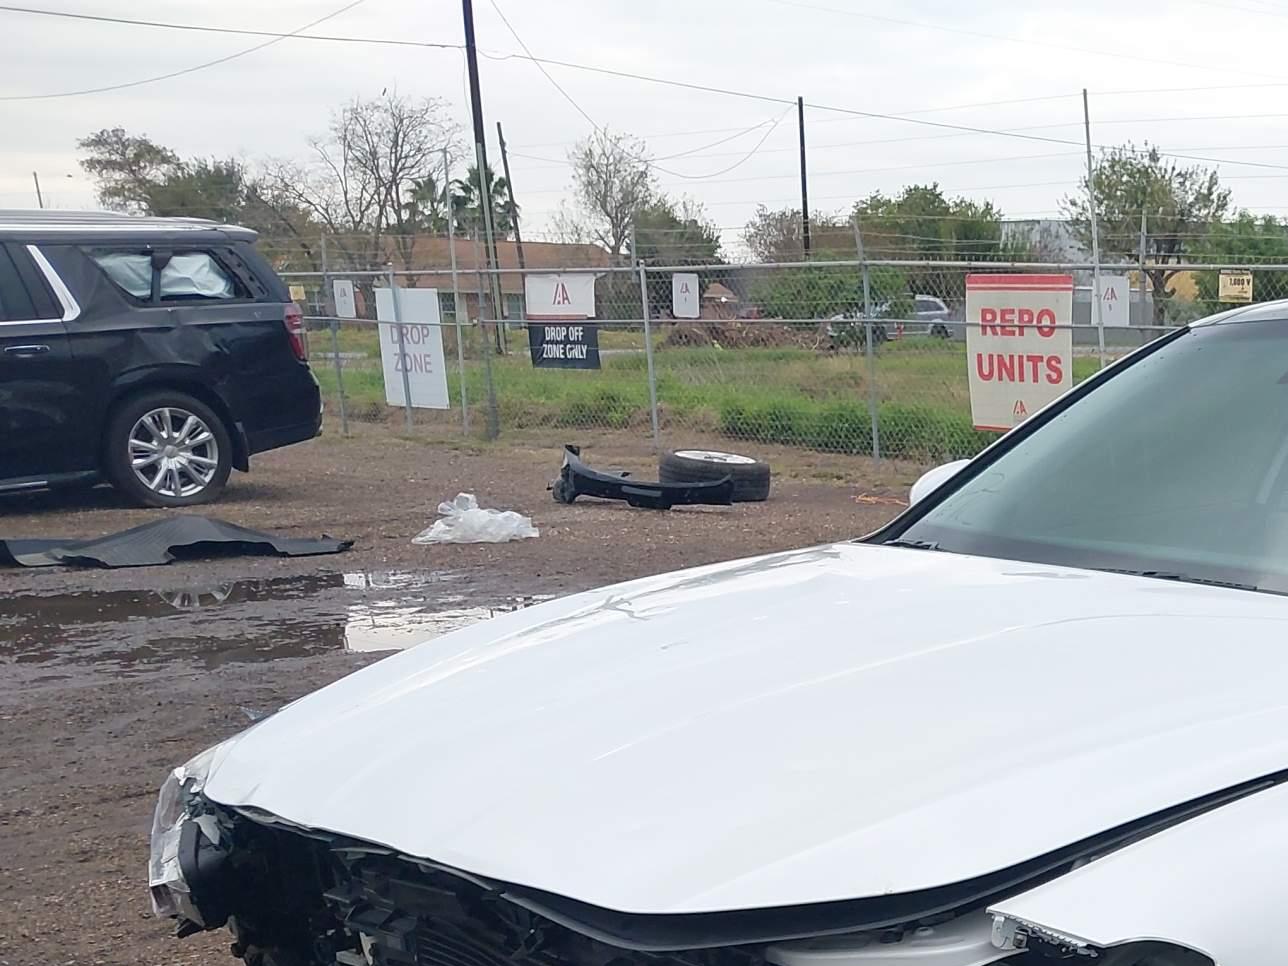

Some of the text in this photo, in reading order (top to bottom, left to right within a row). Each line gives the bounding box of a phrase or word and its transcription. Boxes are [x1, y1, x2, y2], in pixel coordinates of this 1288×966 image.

[544, 326, 584, 341] DROP OFF
[980, 308, 1056, 338] REPO
[390, 324, 430, 345] DROP
[542, 344, 588, 360] ZONE ONLY
[393, 352, 433, 374] ZONE
[976, 353, 1064, 385] UNITS
